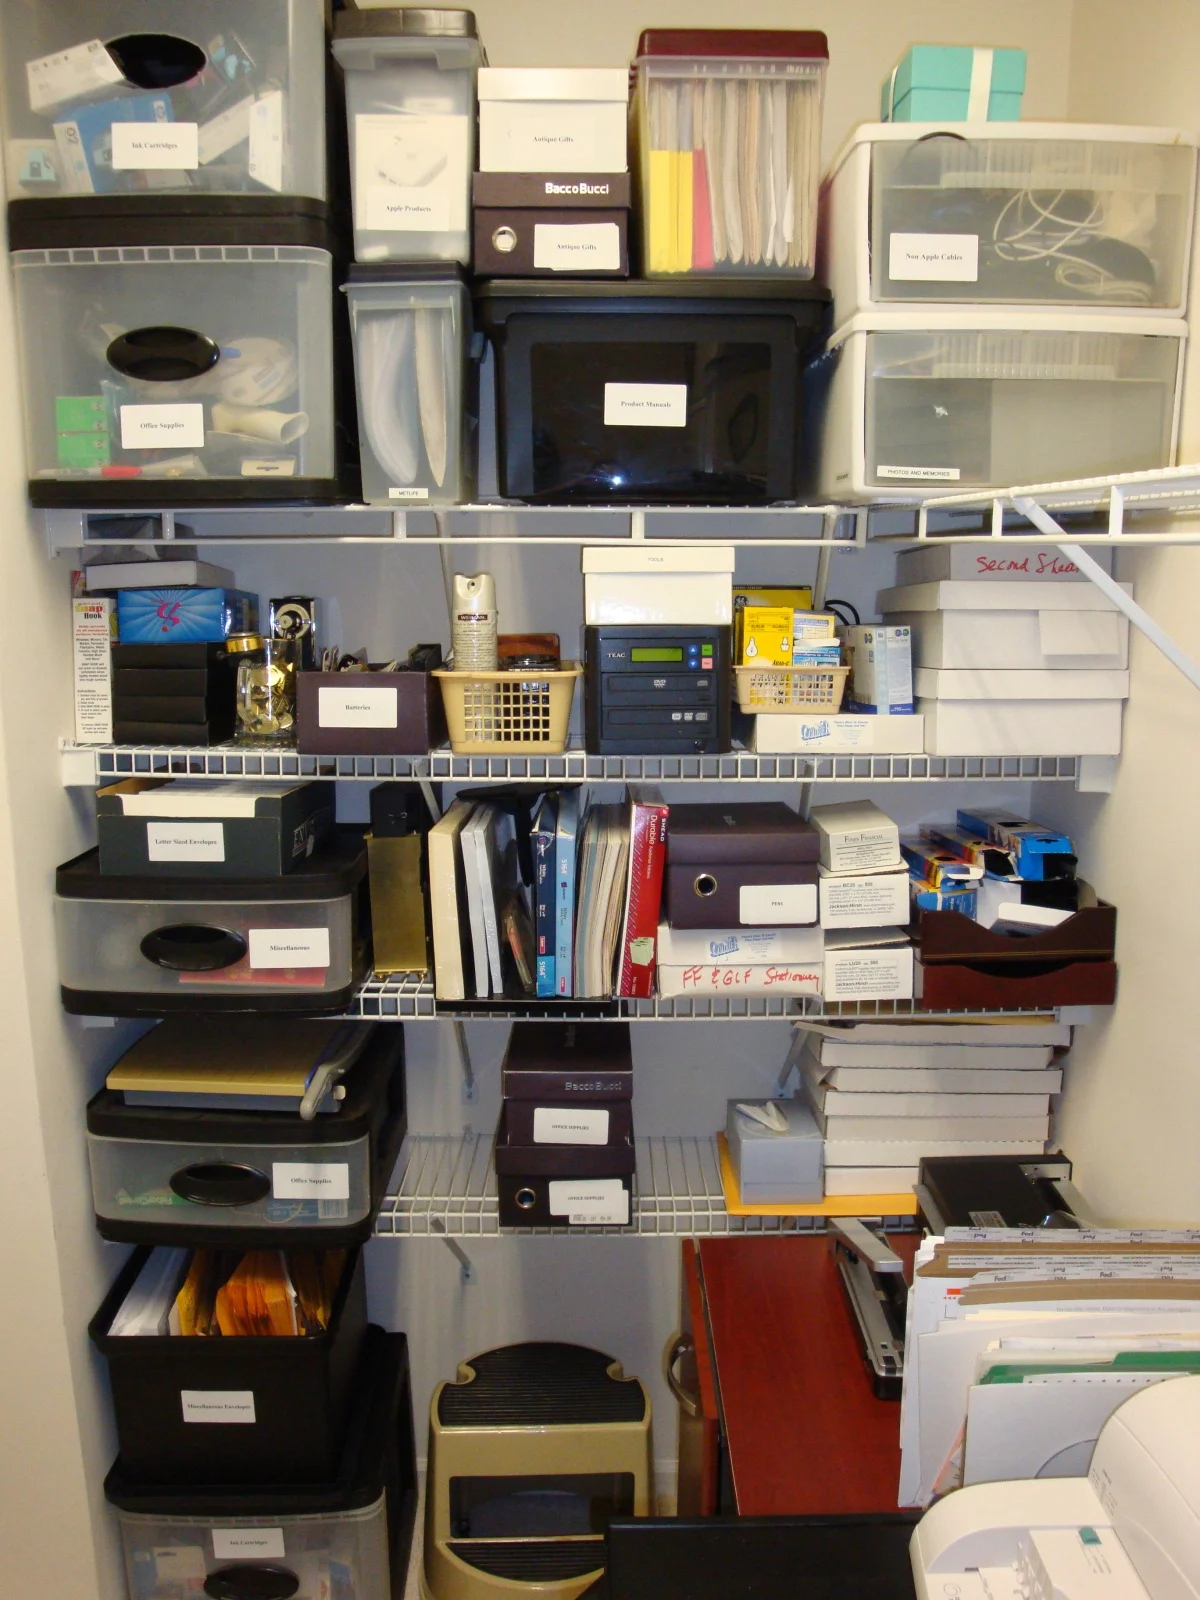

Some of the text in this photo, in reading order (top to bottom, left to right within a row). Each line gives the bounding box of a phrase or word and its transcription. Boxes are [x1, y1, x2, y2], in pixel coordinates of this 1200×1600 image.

[144, 142, 178, 150] Cartridges
[556, 243, 581, 251] Antique
[159, 422, 185, 430] Supplies
[976, 556, 1030, 574] Second
[648, 814, 658, 845] Durable
